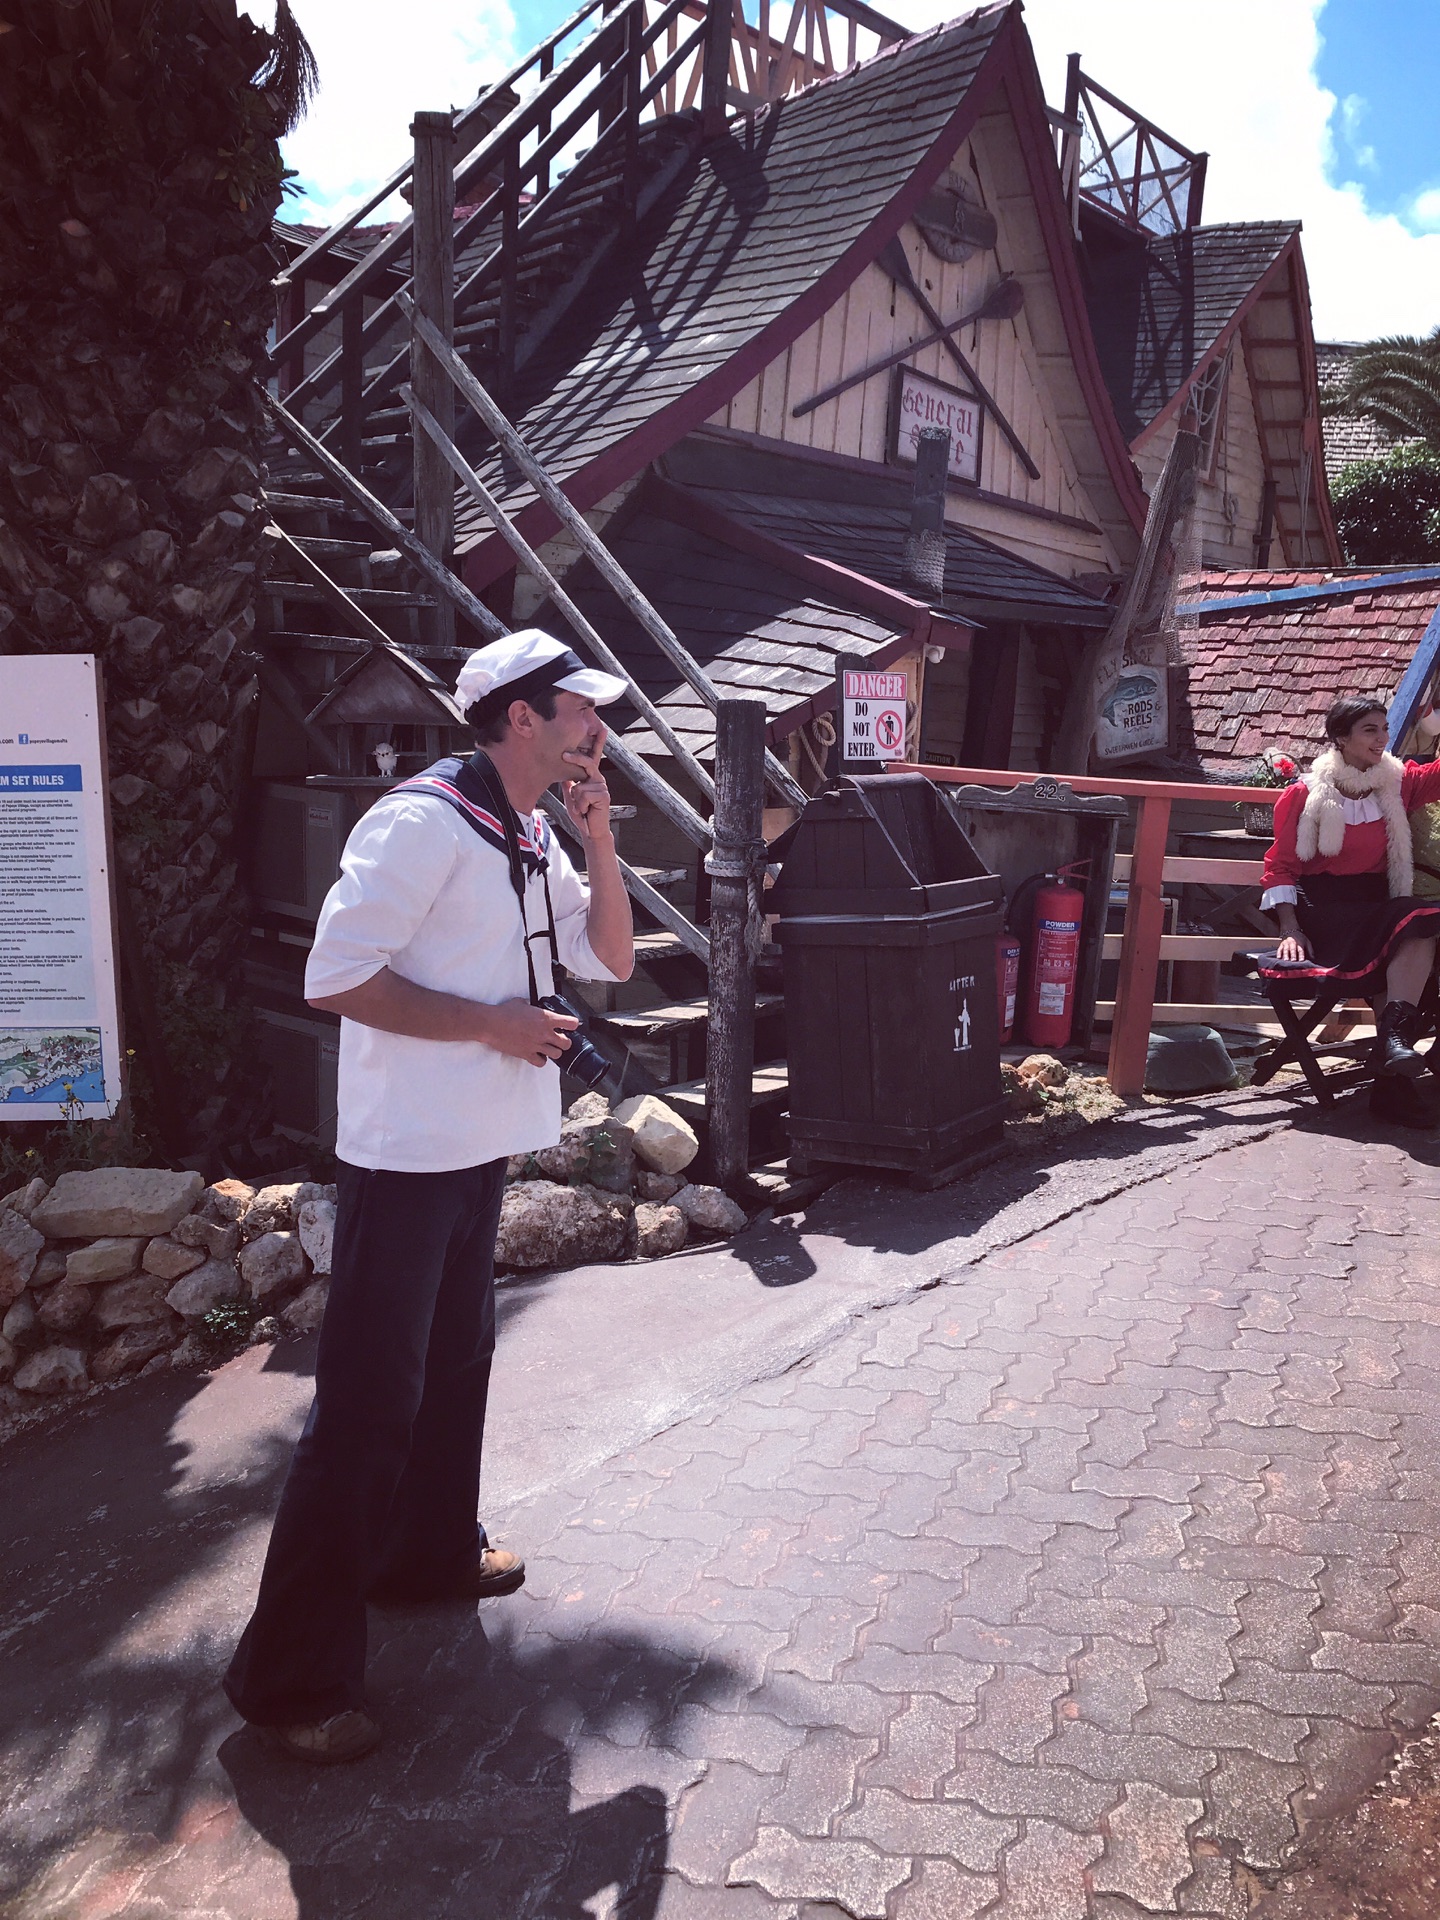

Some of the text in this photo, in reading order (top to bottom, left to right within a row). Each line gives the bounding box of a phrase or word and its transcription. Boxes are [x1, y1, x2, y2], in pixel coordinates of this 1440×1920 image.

[848, 674, 903, 698] DANGER
[855, 701, 868, 716] DO
[1128, 699, 1153, 715] RODS
[1123, 713, 1152, 729] REELS
[852, 722, 870, 736] NOT
[848, 742, 875, 757] ENTER
[0, 775, 64, 786] M SET RULES
